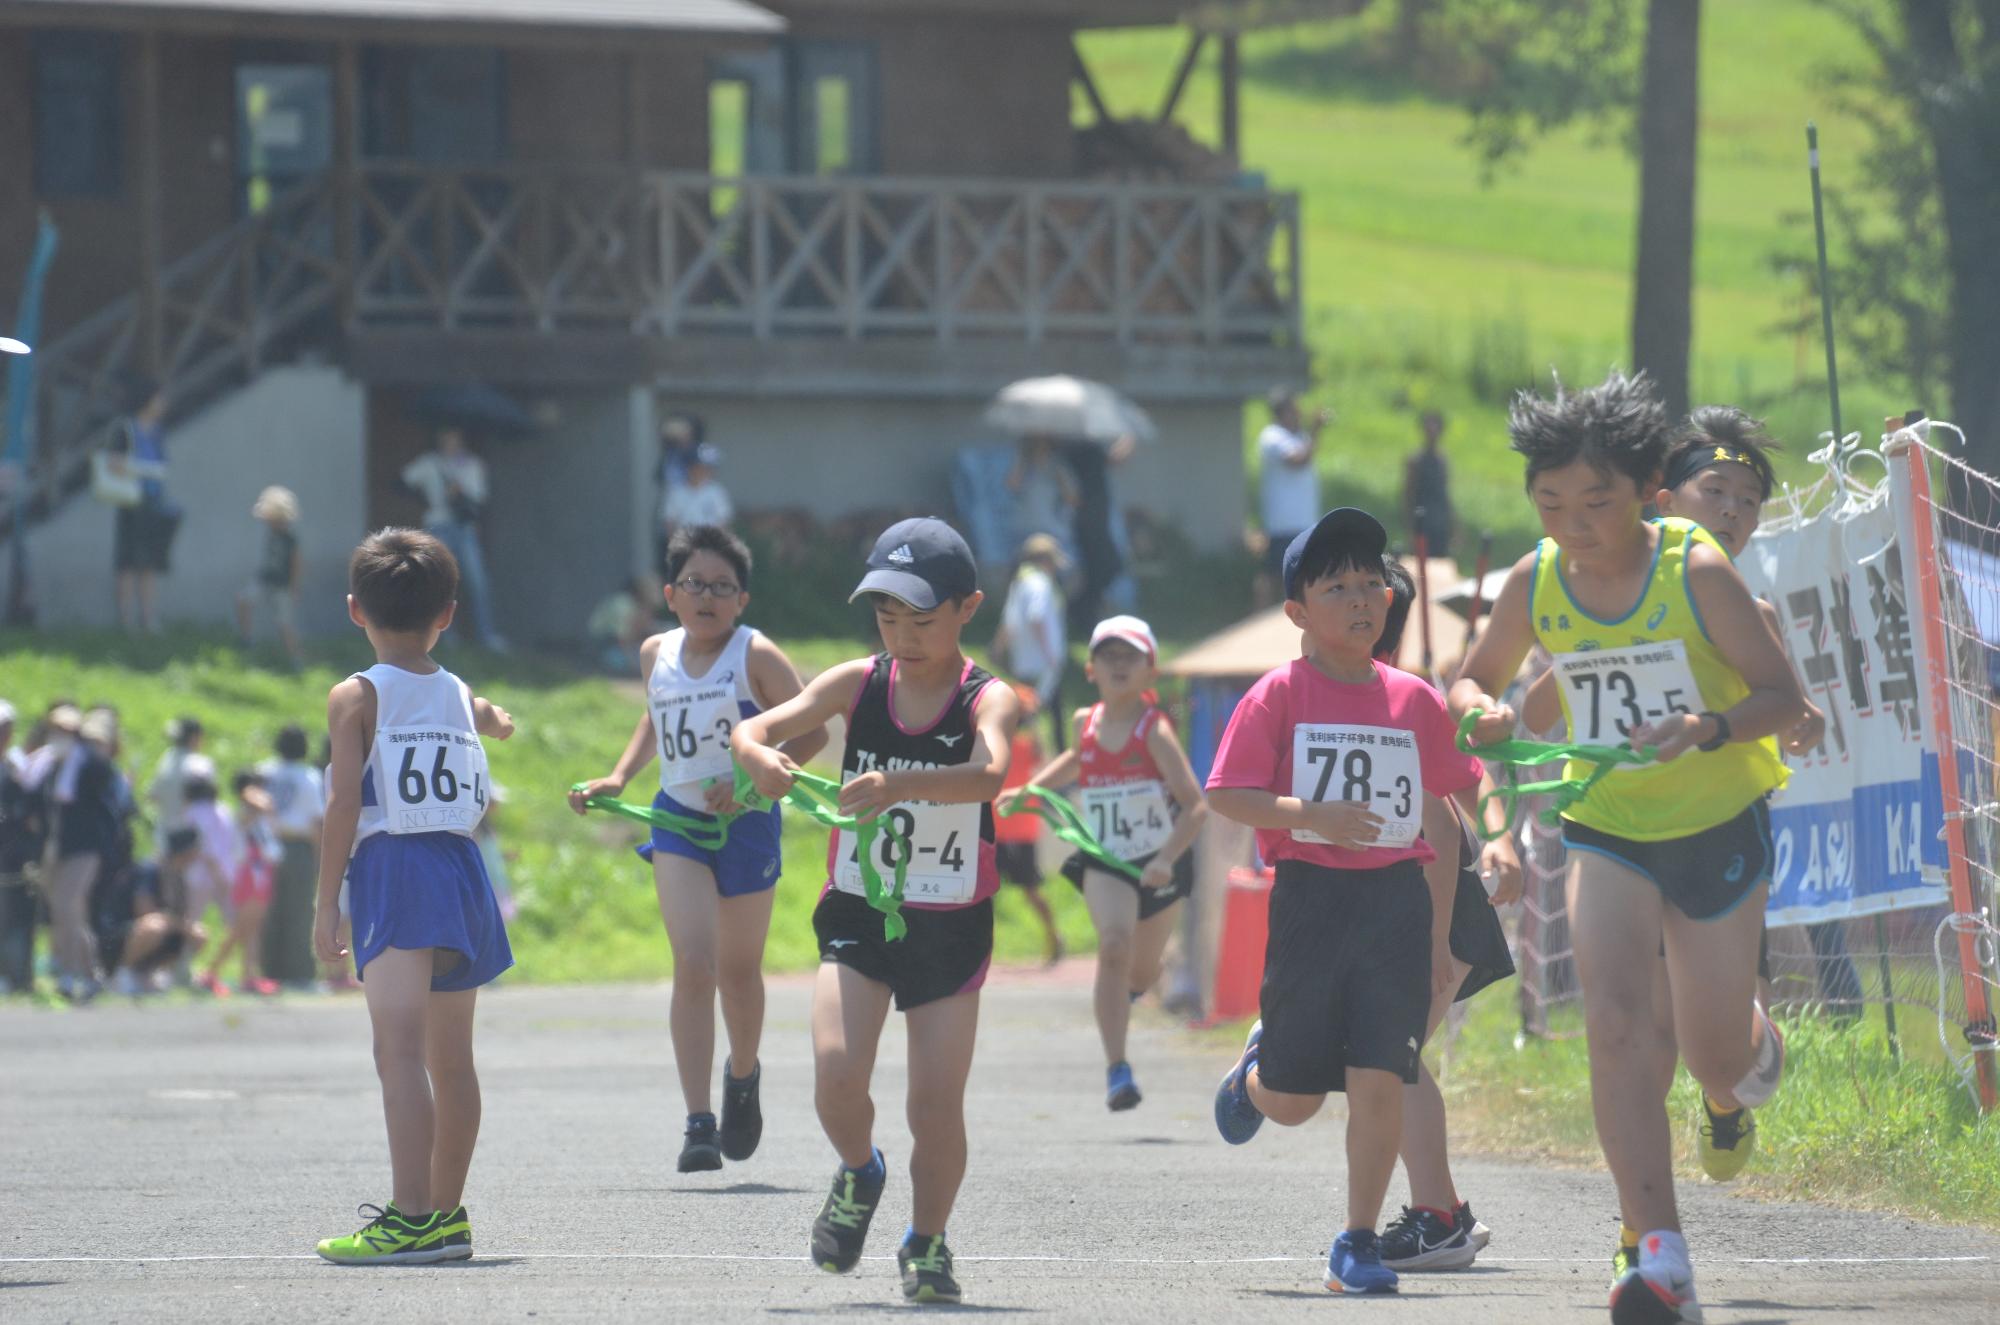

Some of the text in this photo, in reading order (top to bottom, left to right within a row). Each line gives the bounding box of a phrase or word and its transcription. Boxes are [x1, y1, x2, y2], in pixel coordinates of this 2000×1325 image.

[661, 708, 732, 761] 66-3
[1570, 670, 1691, 739] 73-5
[398, 746, 485, 811] 66-4
[1307, 747, 1412, 818] 78-3
[850, 808, 964, 872] 8-4
[1089, 802, 1164, 843] 74-4
